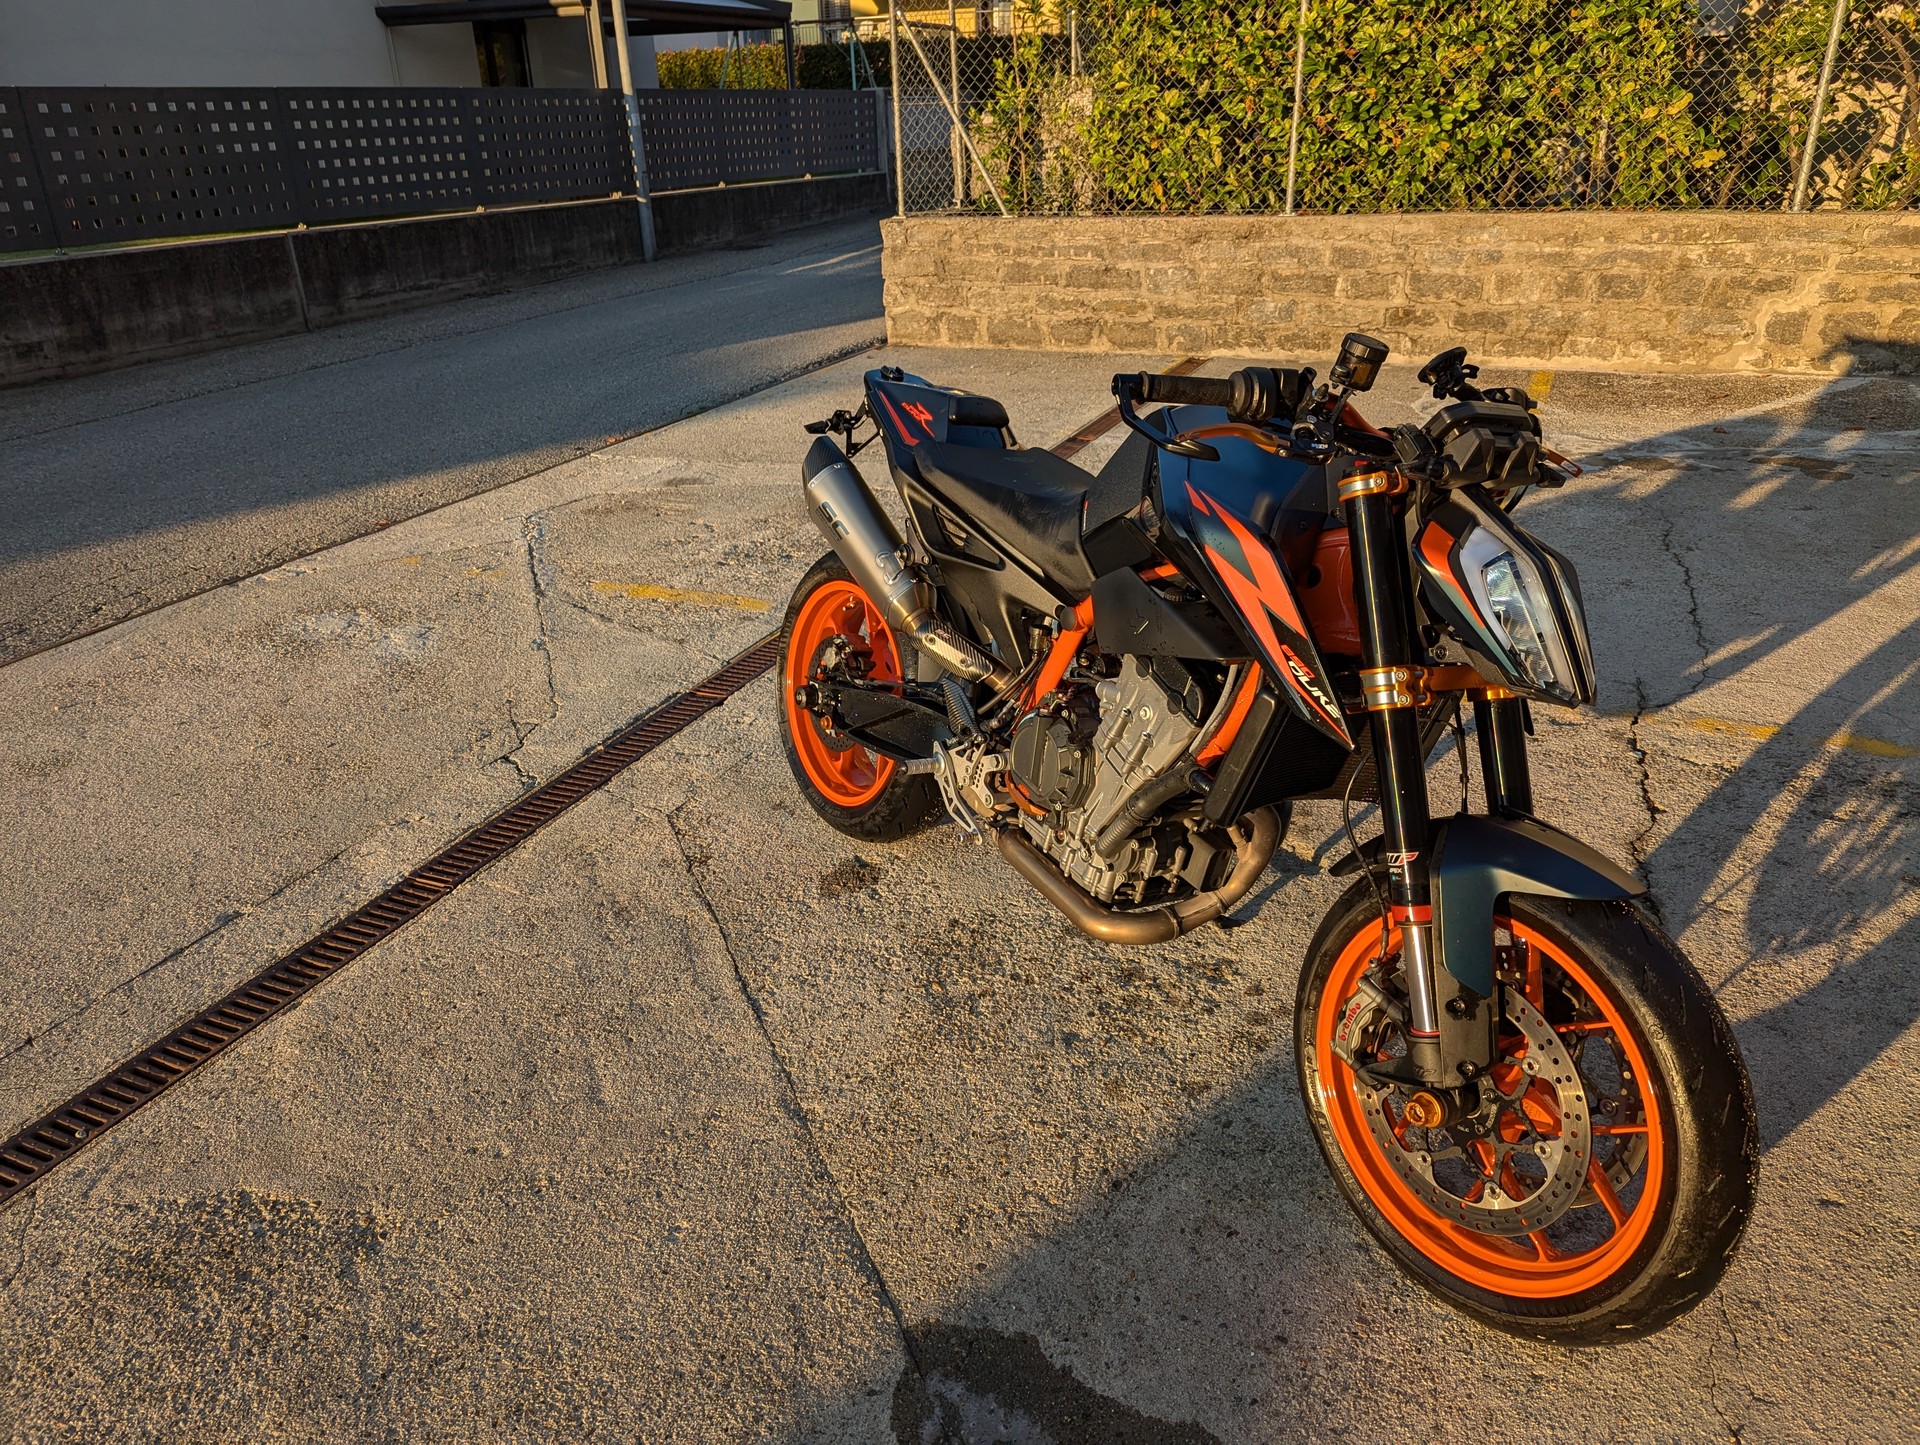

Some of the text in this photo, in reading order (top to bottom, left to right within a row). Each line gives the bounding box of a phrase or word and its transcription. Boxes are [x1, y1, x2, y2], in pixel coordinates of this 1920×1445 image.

[821, 501, 850, 541] SC
[1287, 660, 1341, 718] DUKE
[1386, 851, 1419, 866] WP
[1338, 1002, 1362, 1042] brembo
